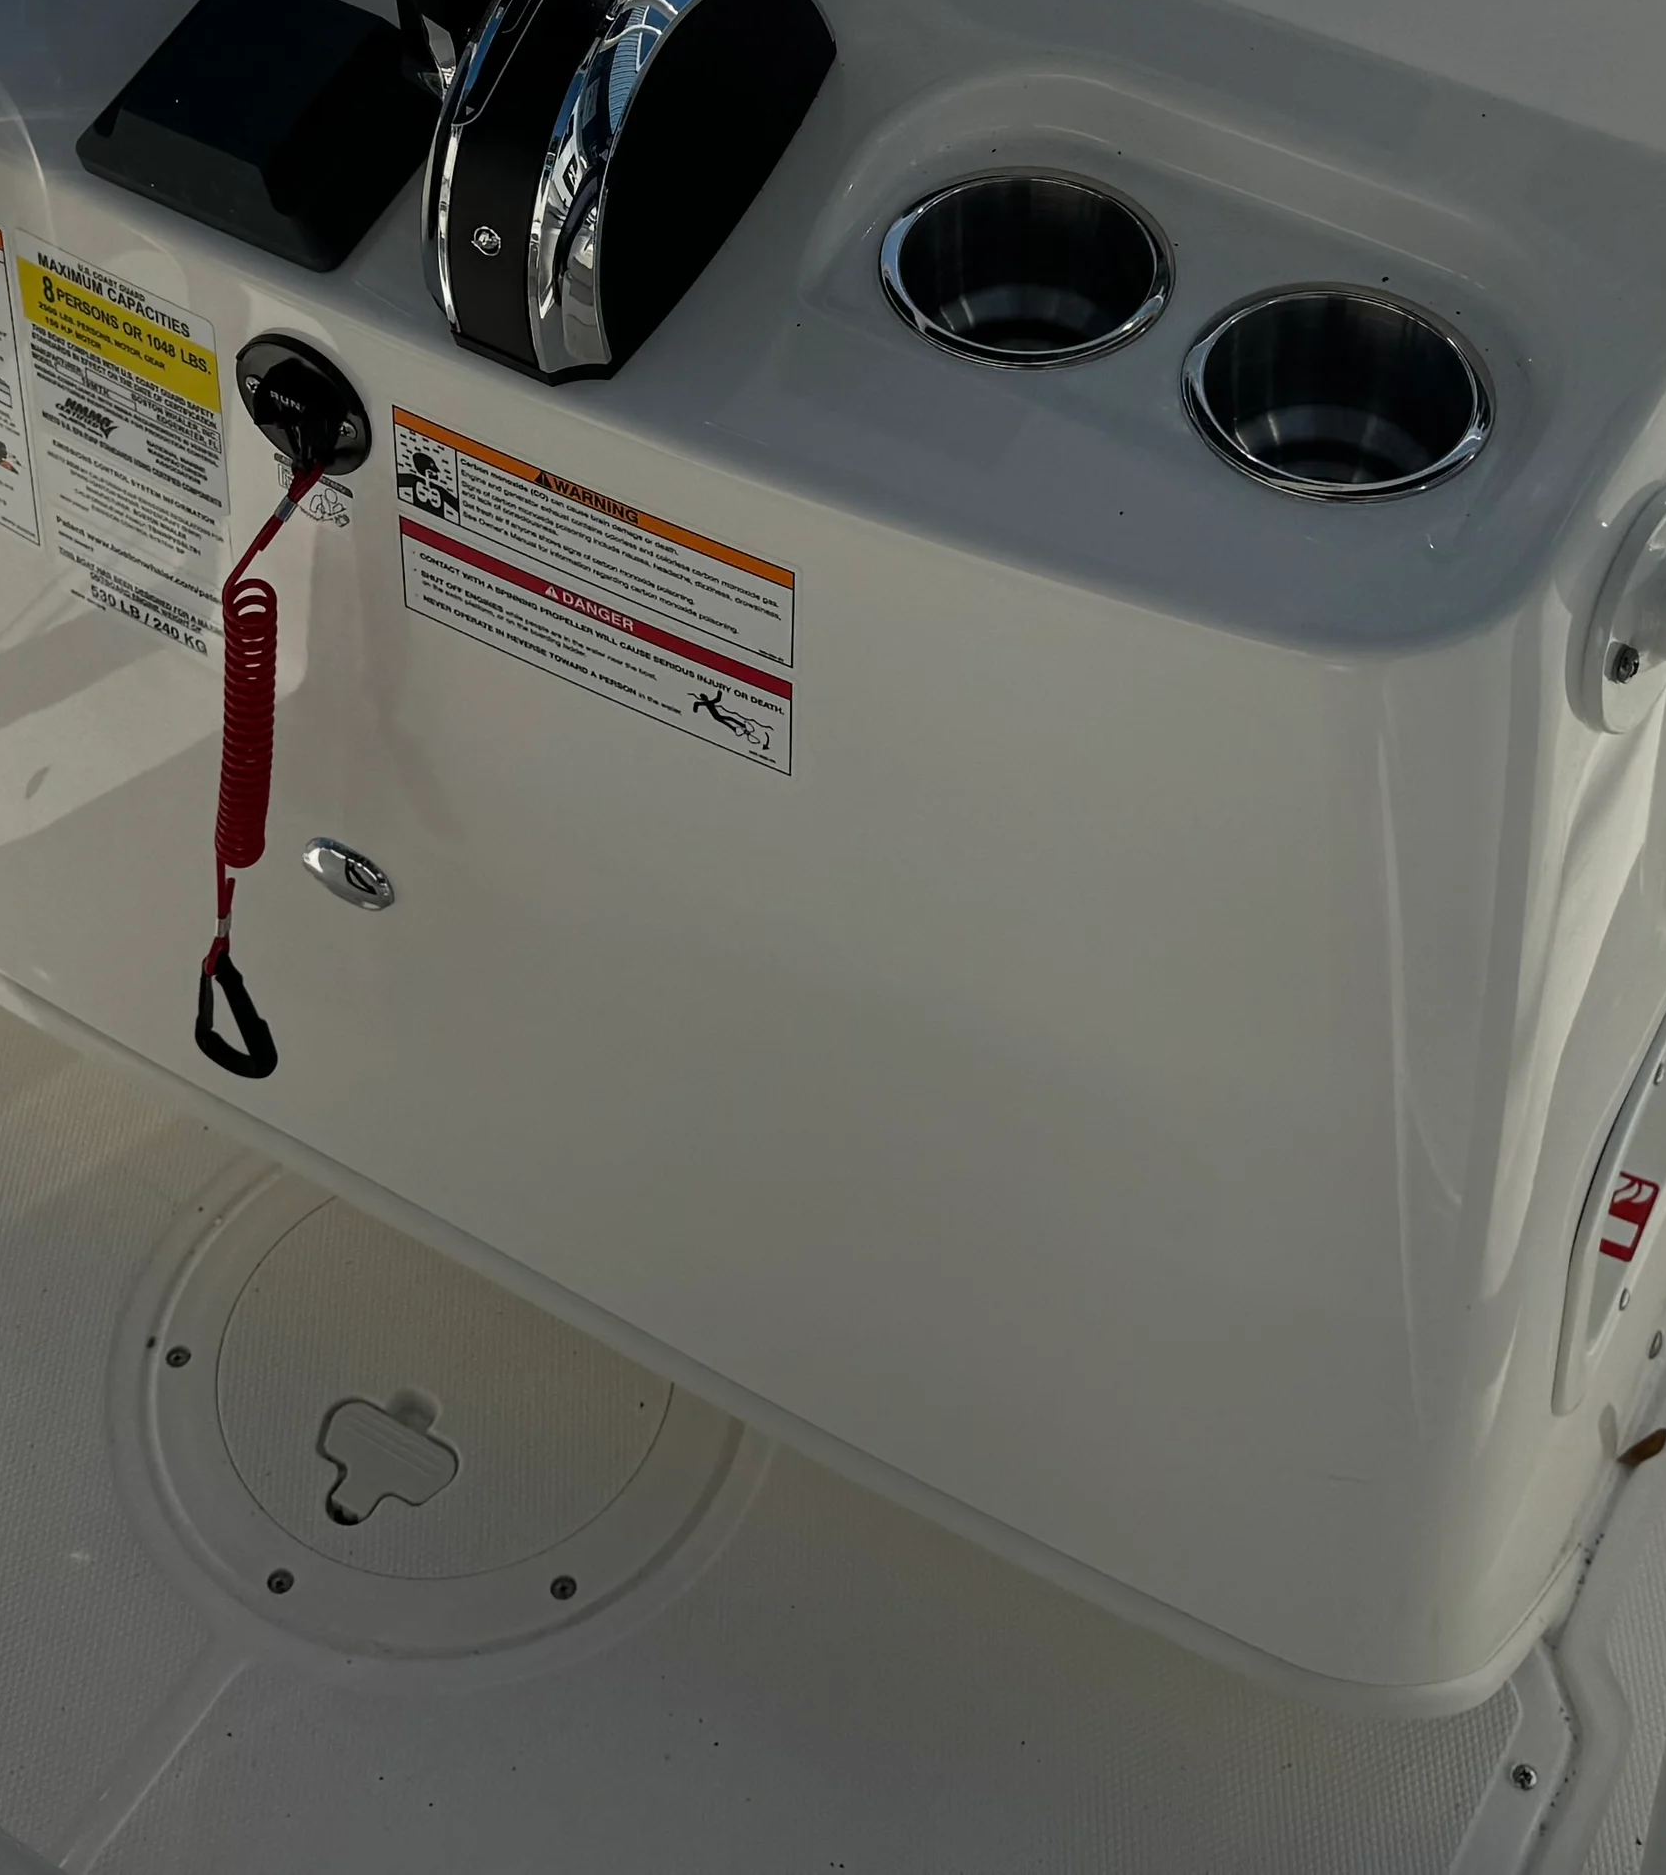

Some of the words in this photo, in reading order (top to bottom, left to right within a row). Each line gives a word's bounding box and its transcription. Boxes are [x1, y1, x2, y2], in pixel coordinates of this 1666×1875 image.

[37, 252, 103, 297] MAXIMUM
[107, 285, 190, 338] CAPACITIES
[42, 274, 54, 304] 8
[93, 270, 117, 289] COAST
[119, 283, 145, 302] GUARD
[56, 287, 118, 330] PERSONS
[122, 319, 142, 342] OR
[146, 331, 175, 358] 1048
[180, 348, 210, 375] LBS.
[75, 330, 101, 350] MOTOR
[144, 353, 165, 370] GEAR
[269, 390, 301, 411] RUN
[460, 457, 488, 476] Carbon
[491, 470, 528, 493] monoxide
[530, 487, 548, 501] (CO)
[550, 496, 564, 508] can
[566, 502, 588, 518] cause
[590, 513, 609, 527] brain
[612, 522, 642, 542] damage
[645, 536, 652, 545] or
[655, 540, 678, 556] death.
[553, 477, 638, 524] WARNING
[421, 569, 443, 586] SHUT
[446, 581, 462, 594] OFF
[464, 589, 503, 613] ENGINES
[562, 591, 633, 632] DANGER
[90, 584, 116, 607] 530
[120, 599, 140, 620] LB
[153, 617, 180, 640] 240
[184, 632, 208, 655] KG
[419, 552, 459, 576] CONTACT
[462, 570, 484, 587] WITH
[486, 581, 493, 591] A
[495, 584, 537, 610] SPINNING
[540, 604, 592, 634] PROPELLER
[595, 628, 617, 644] WILL
[619, 638, 650, 659] CAUSE
[653, 653, 694, 678] SERIOUS
[697, 672, 730, 693] INJURY
[734, 688, 747, 701] OR
[750, 695, 784, 717] DEATH.
[423, 594, 451, 613] NEVER
[453, 608, 493, 632] OPERATE
[495, 627, 504, 637] IN
[506, 632, 546, 656] REVERSE
[549, 651, 587, 674] TOWARD
[590, 669, 598, 679] A
[599, 673, 636, 696] PERSON
